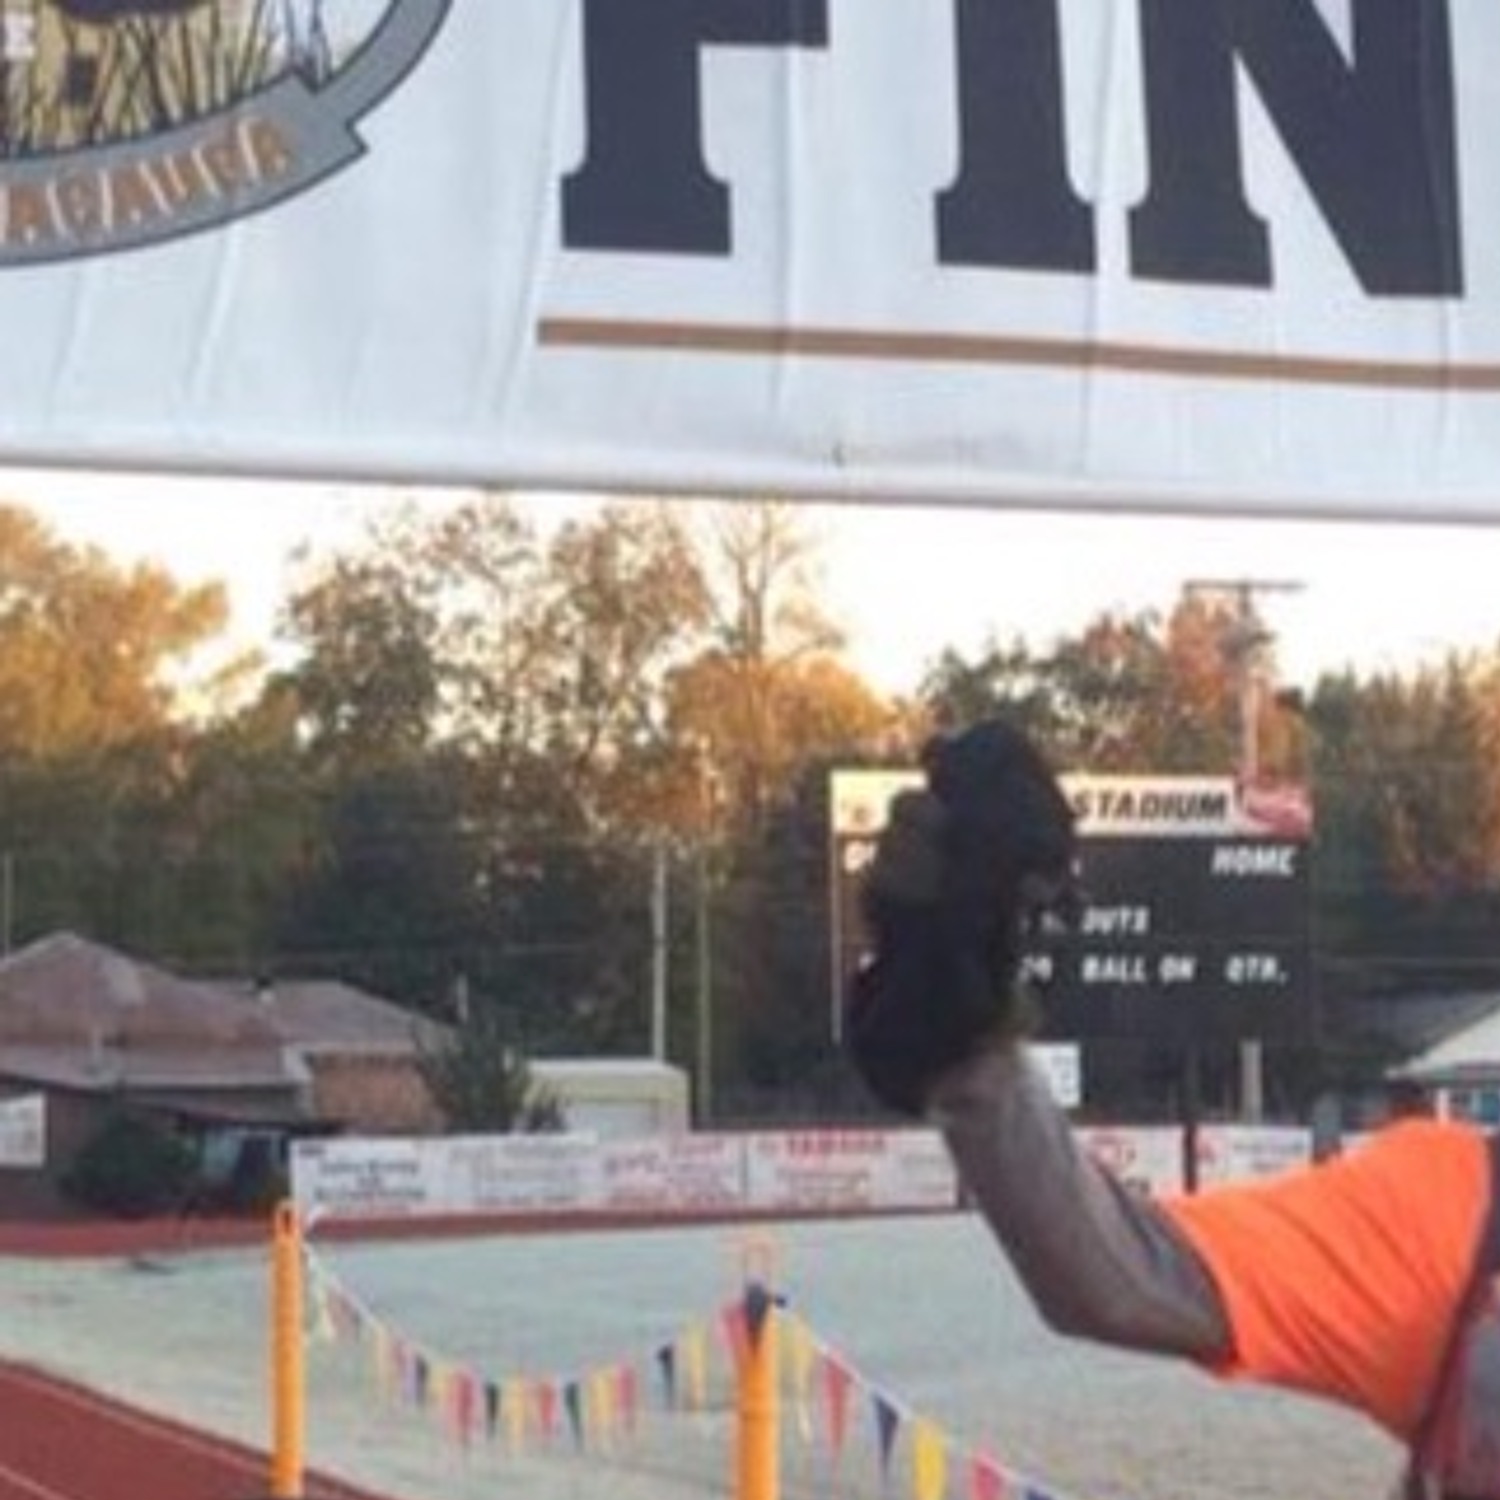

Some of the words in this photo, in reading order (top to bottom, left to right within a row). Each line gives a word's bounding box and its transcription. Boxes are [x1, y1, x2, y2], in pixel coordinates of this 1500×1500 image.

[1074, 788, 1226, 820] STADIUM
[1211, 846, 1297, 876] HOME
[1081, 905, 1150, 935] OUTS
[1083, 955, 1146, 982] BALL
[1158, 955, 1197, 983] ON
